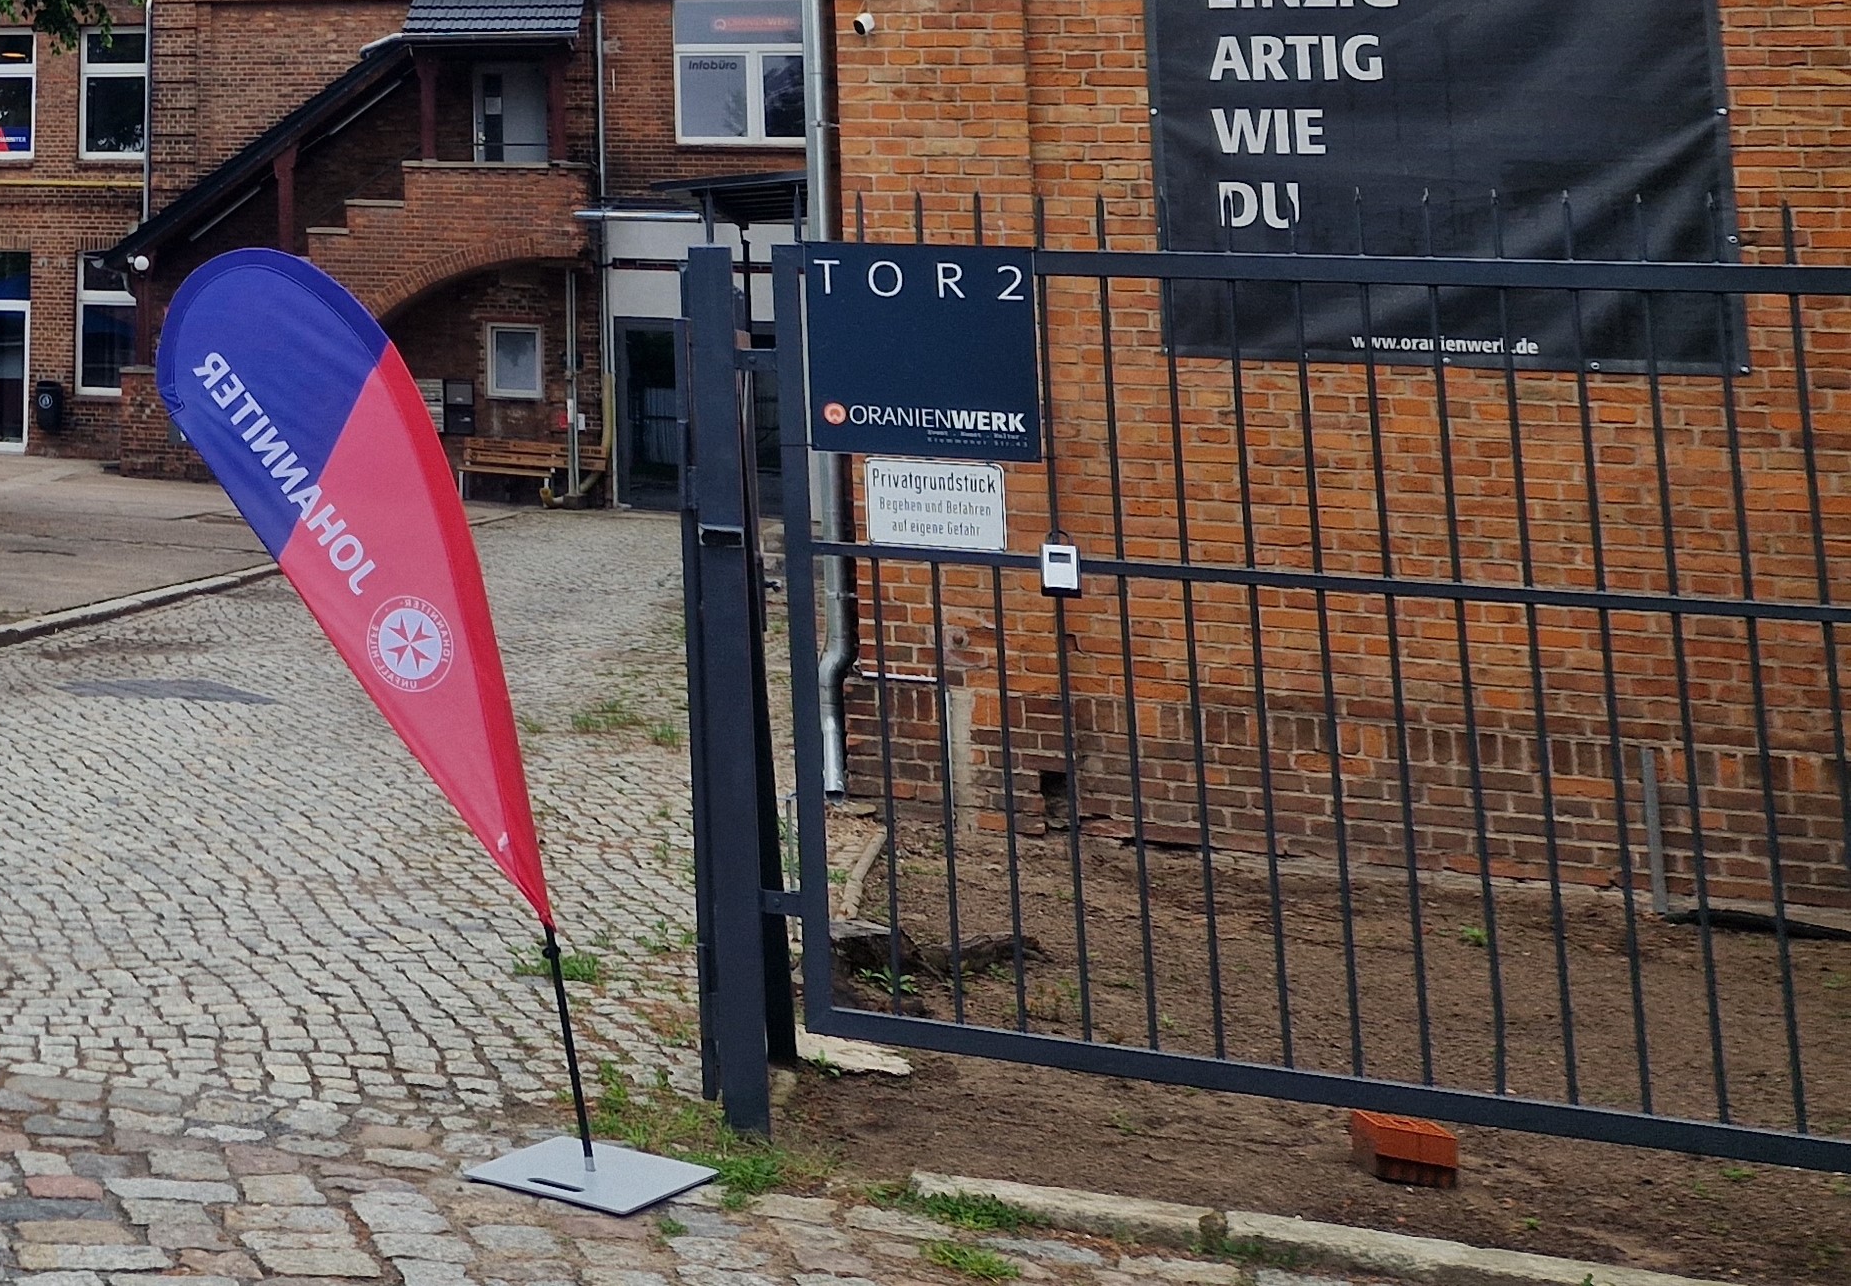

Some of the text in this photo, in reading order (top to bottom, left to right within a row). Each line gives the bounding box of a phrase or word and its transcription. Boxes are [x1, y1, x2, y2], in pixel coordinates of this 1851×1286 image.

[689, 60, 737, 70] Infobüro
[1209, 33, 1385, 83] ARTIG
[1210, 107, 1328, 156] WIE
[1218, 181, 1300, 229] DU
[849, 404, 1027, 433] ORANIENWERK
[872, 467, 996, 494] Privatgrundstück
[879, 496, 992, 517] Begehen und Befahren
[892, 519, 981, 537] auf eigene Gefahr
